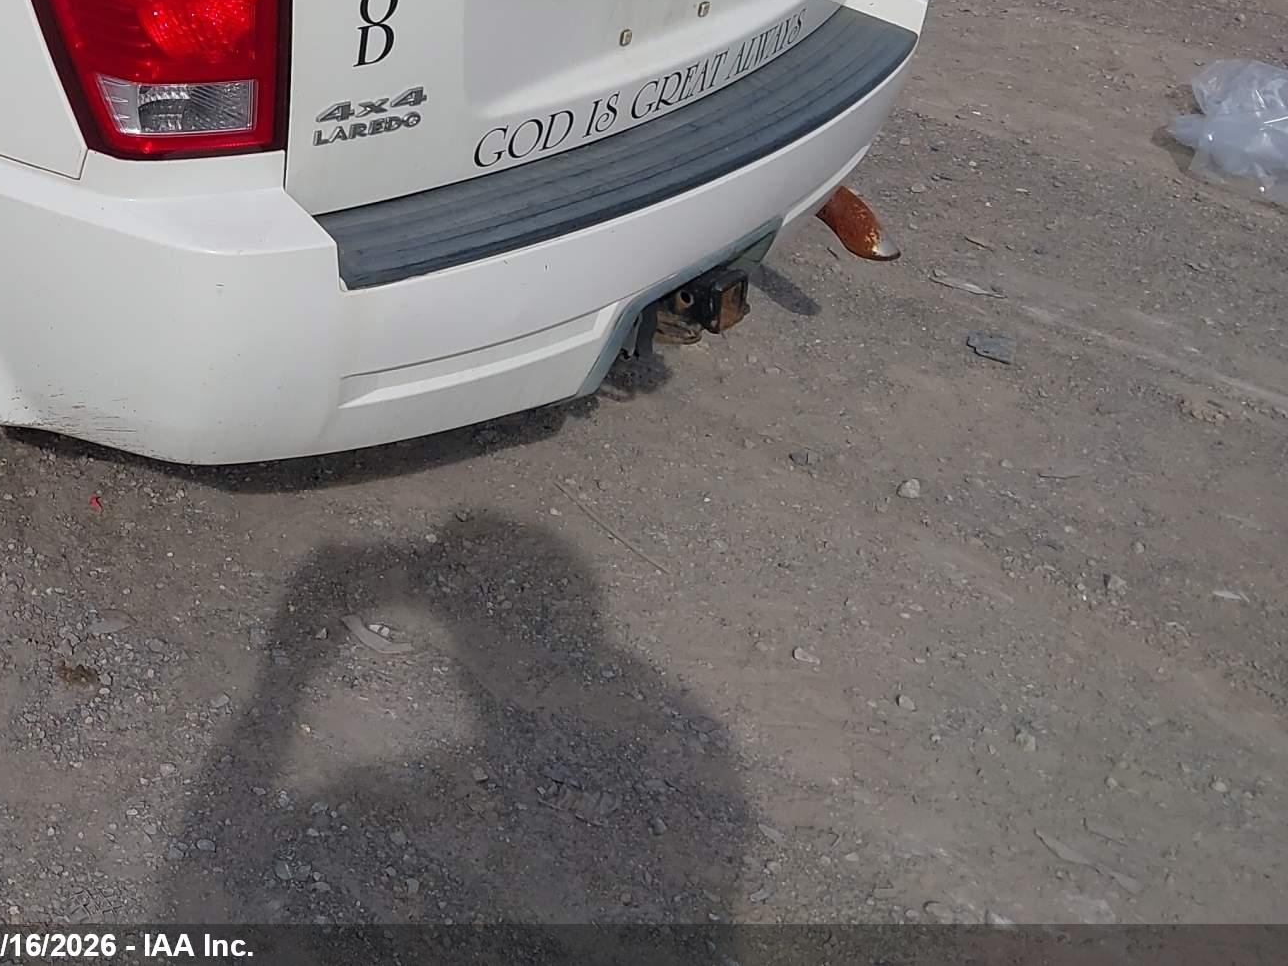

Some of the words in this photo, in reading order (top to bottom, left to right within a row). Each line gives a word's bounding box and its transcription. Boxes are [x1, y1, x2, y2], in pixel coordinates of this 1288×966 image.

[316, 86, 427, 122] 4x4
[473, 110, 574, 168] GOD
[582, 91, 620, 138] IS
[630, 48, 729, 120] GREAT
[725, 8, 806, 80] ALWAYS
[313, 111, 421, 146] LAREDO
